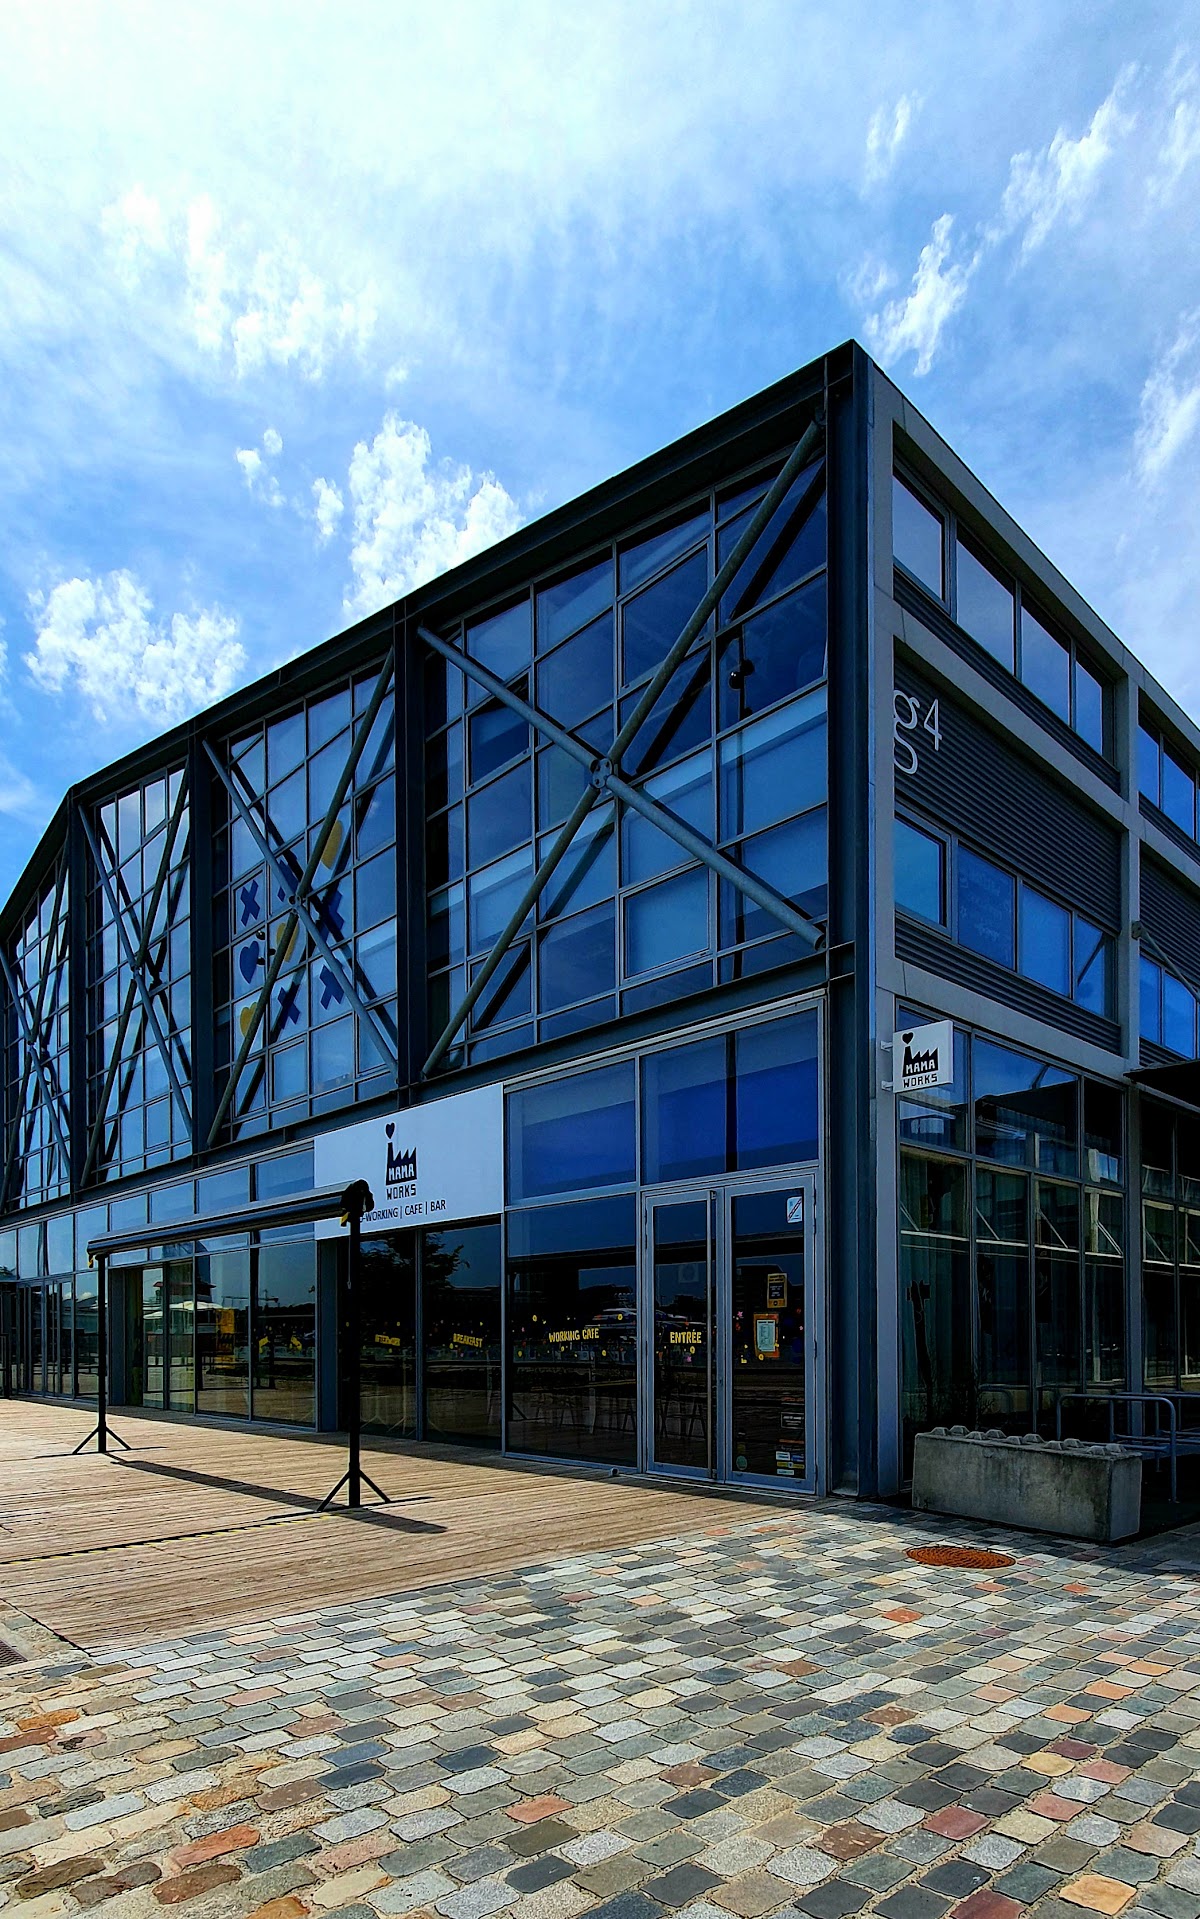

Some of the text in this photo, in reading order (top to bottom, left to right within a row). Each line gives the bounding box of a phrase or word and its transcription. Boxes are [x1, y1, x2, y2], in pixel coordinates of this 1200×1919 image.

[906, 1059, 936, 1074] MAMA
[903, 1074, 938, 1088] WORKS
[388, 1163, 415, 1181] MAMA
[386, 1184, 416, 1200] WORKS
[404, 1203, 423, 1215] CAFE
[430, 1199, 446, 1212] BAR
[548, 1327, 600, 1343] WORKING CAFE
